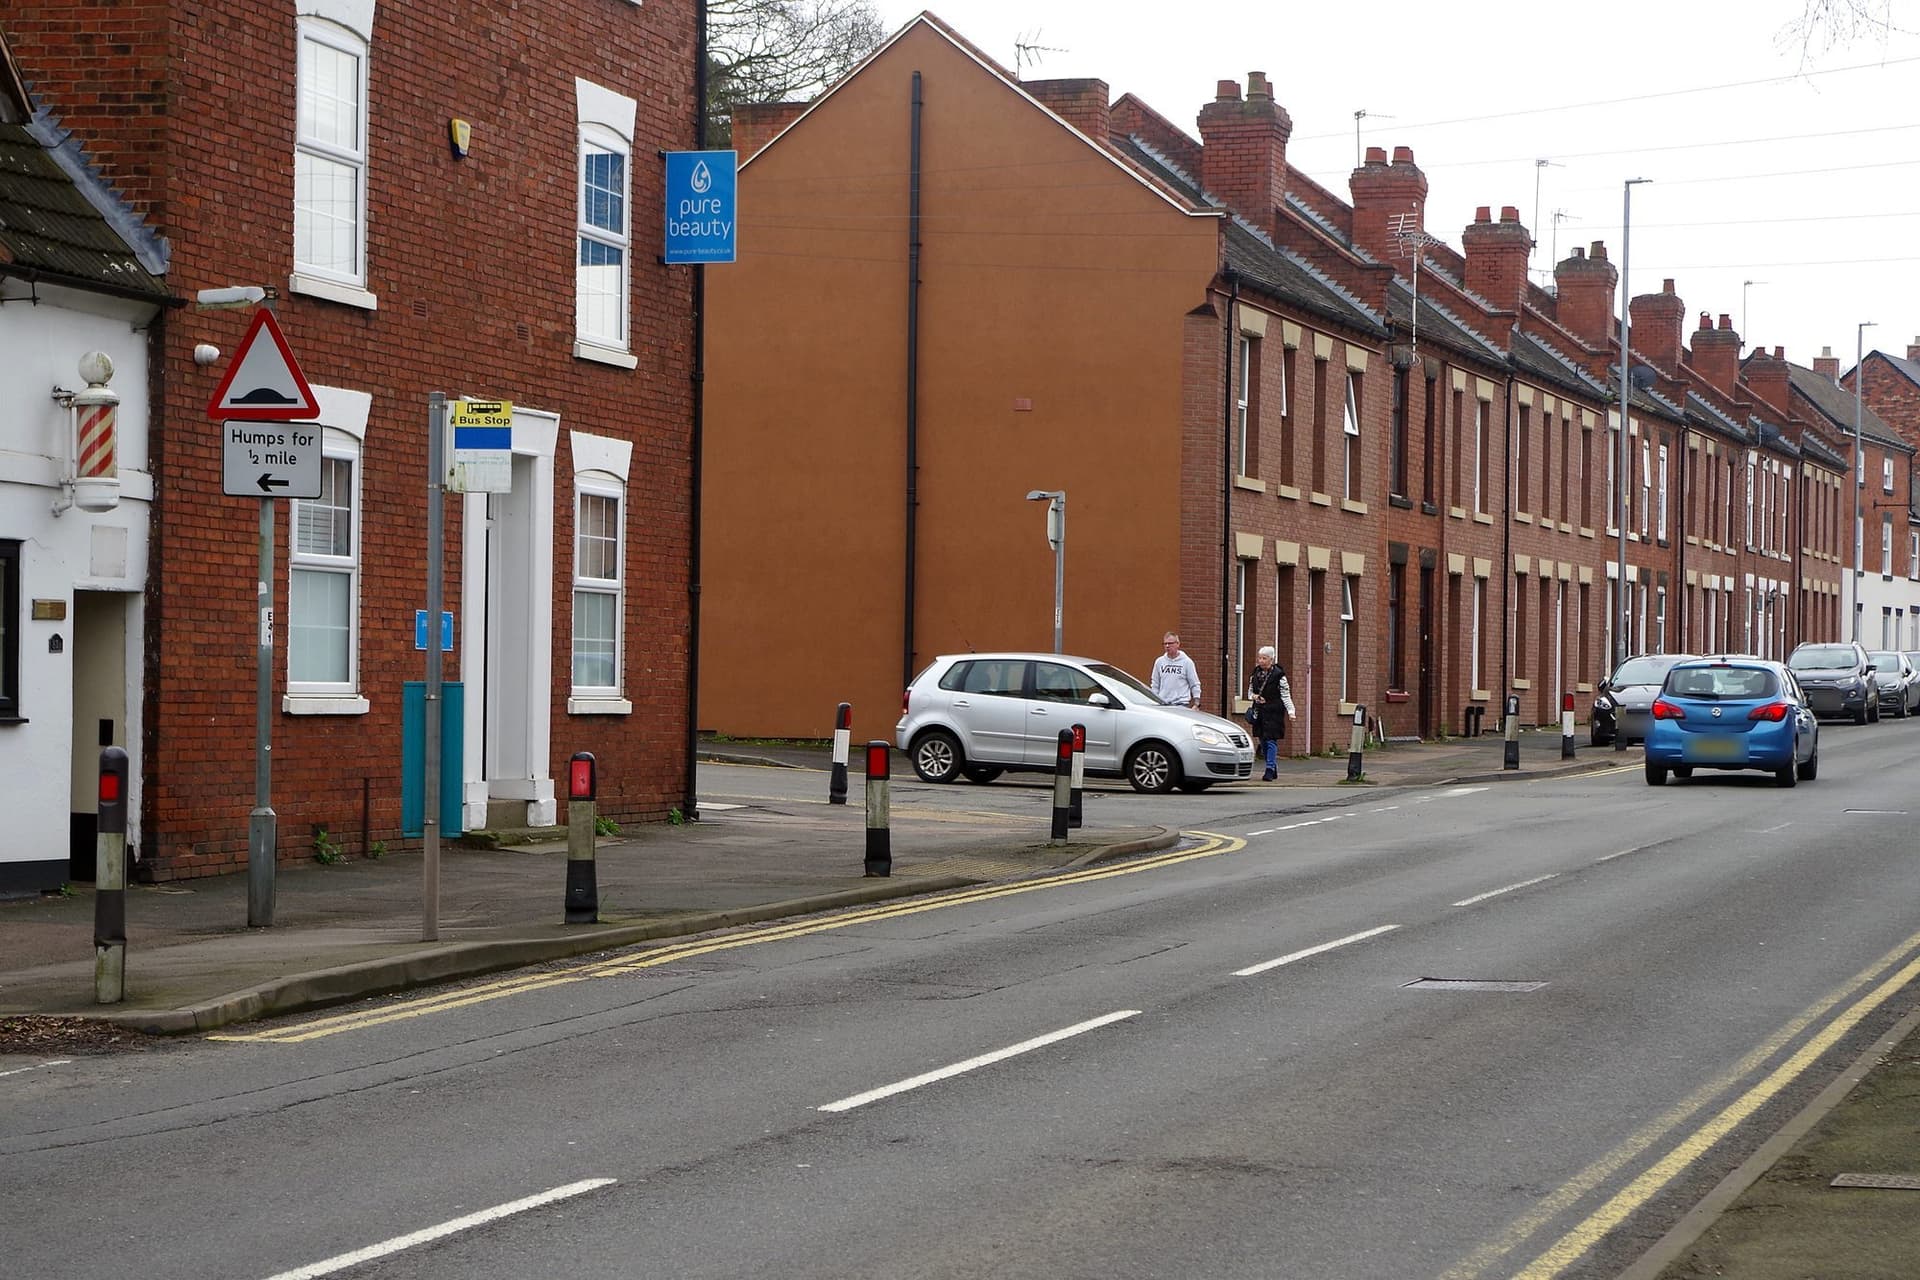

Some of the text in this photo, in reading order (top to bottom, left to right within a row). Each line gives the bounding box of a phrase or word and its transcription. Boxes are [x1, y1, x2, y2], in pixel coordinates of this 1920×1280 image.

[680, 199, 721, 219] pure
[669, 218, 731, 240] beauty
[459, 416, 511, 426] Bus Stop
[232, 429, 314, 447] Humps for
[265, 451, 297, 465] mile
[1160, 665, 1183, 675] VANS
